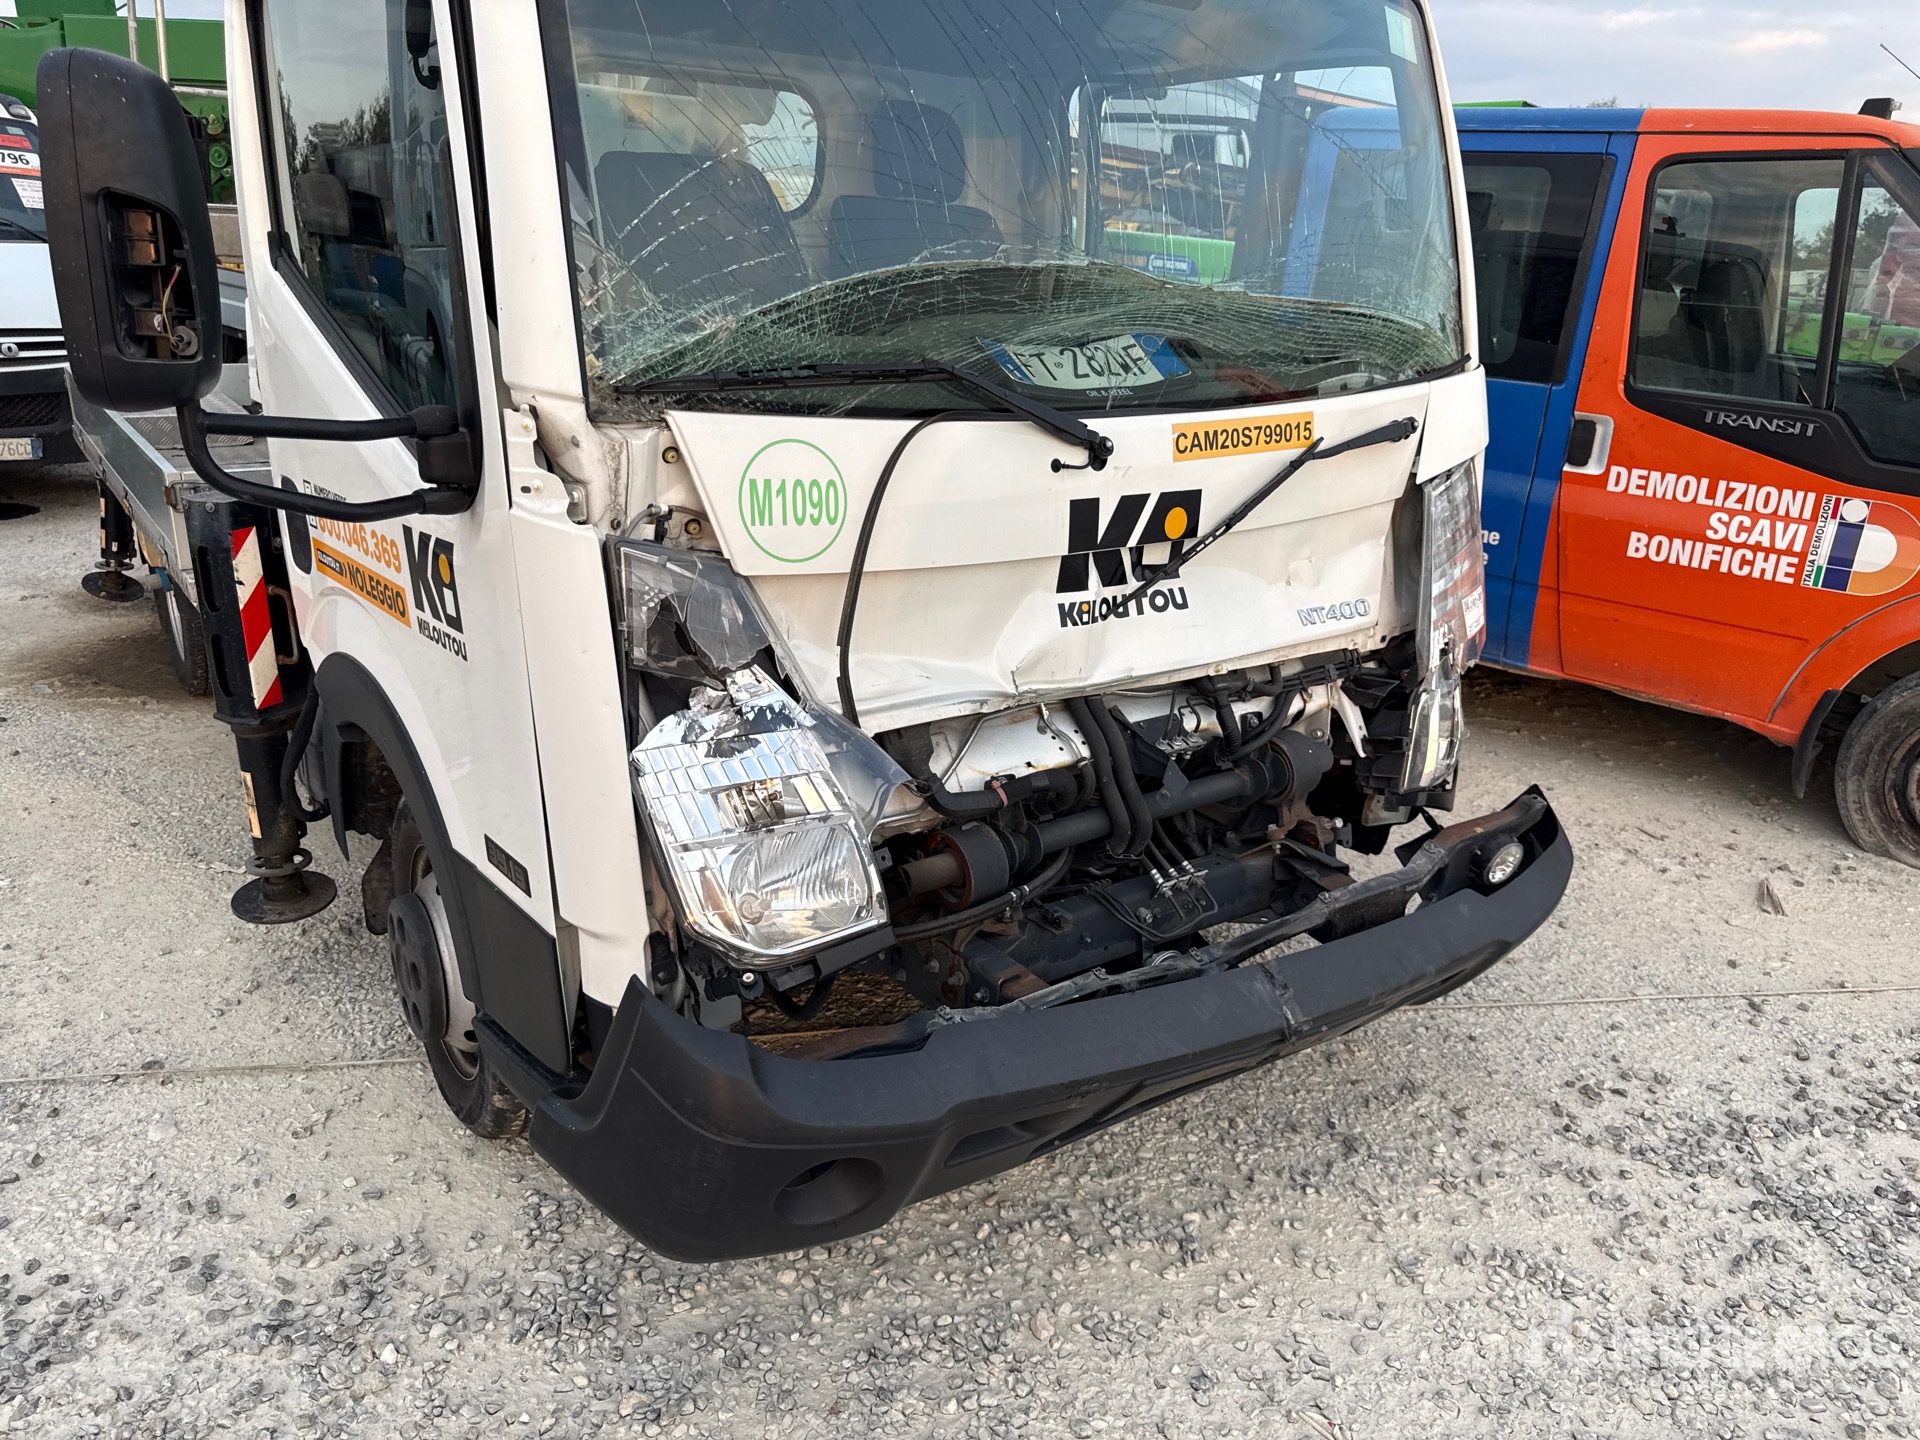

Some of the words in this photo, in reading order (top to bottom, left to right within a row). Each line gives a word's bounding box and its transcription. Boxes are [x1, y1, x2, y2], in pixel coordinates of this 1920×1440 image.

[1086, 389, 1101, 397] OIL
[1175, 420, 1313, 455] CAM20S799015
[1703, 409, 1820, 437] TRANSIT
[749, 477, 840, 527] M1090
[1606, 465, 1817, 520] DEMOLIZIONI
[1706, 511, 1809, 553] SCAVI
[1803, 555, 1817, 586] ITALIA
[1810, 495, 1833, 556] DEMOLIZIONI
[1626, 531, 1799, 585] BONIFICHE
[350, 562, 406, 619] NOLEGGIO
[1297, 598, 1371, 627] NT400
